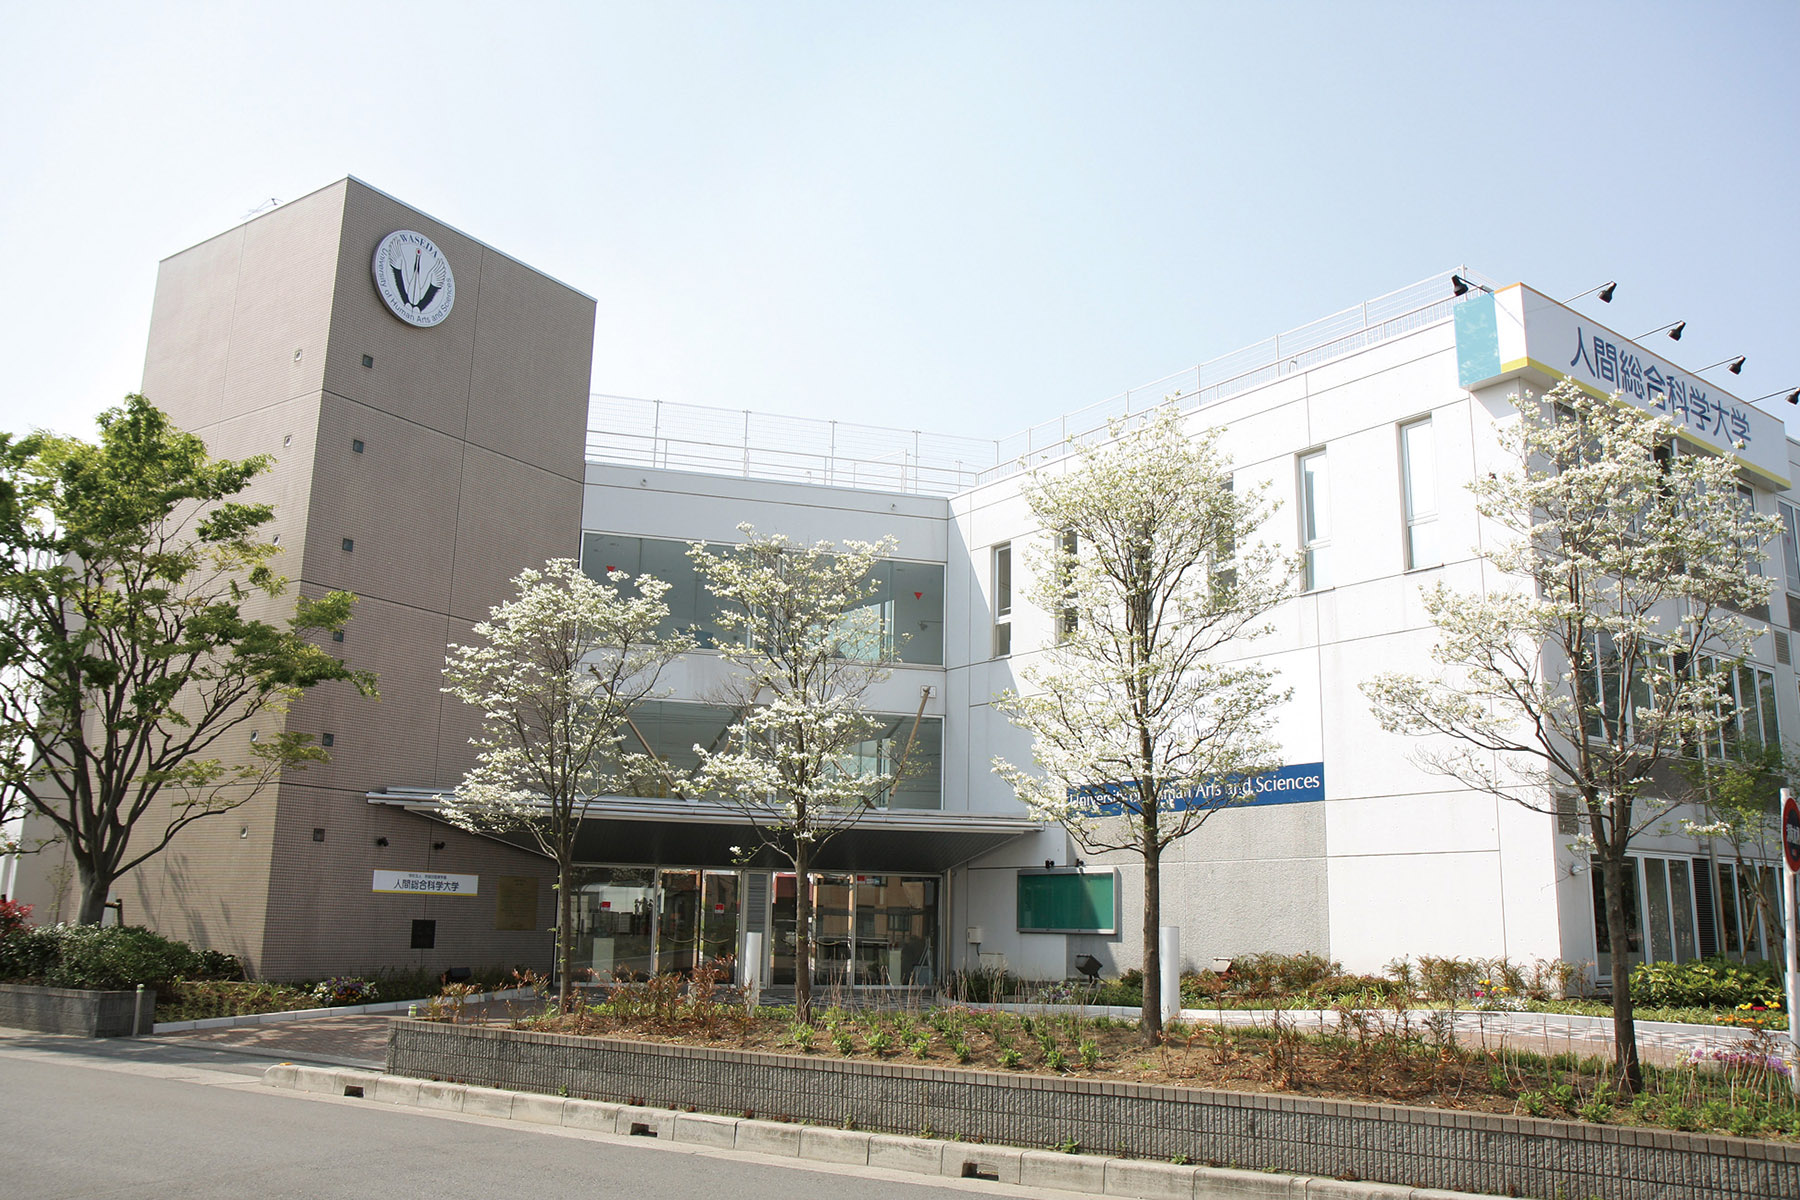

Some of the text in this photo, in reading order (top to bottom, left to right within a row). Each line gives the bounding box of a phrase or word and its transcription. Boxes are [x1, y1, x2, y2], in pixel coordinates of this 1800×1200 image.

[400, 234, 438, 258] WASEDA
[379, 248, 452, 323] University of Human Arts and Sciences
[1570, 326, 1752, 451] 人間総合科学大学
[1195, 782, 1221, 798] Arts
[1255, 775, 1320, 793] Sciences
[393, 879, 459, 892] 人間総合科学大学
